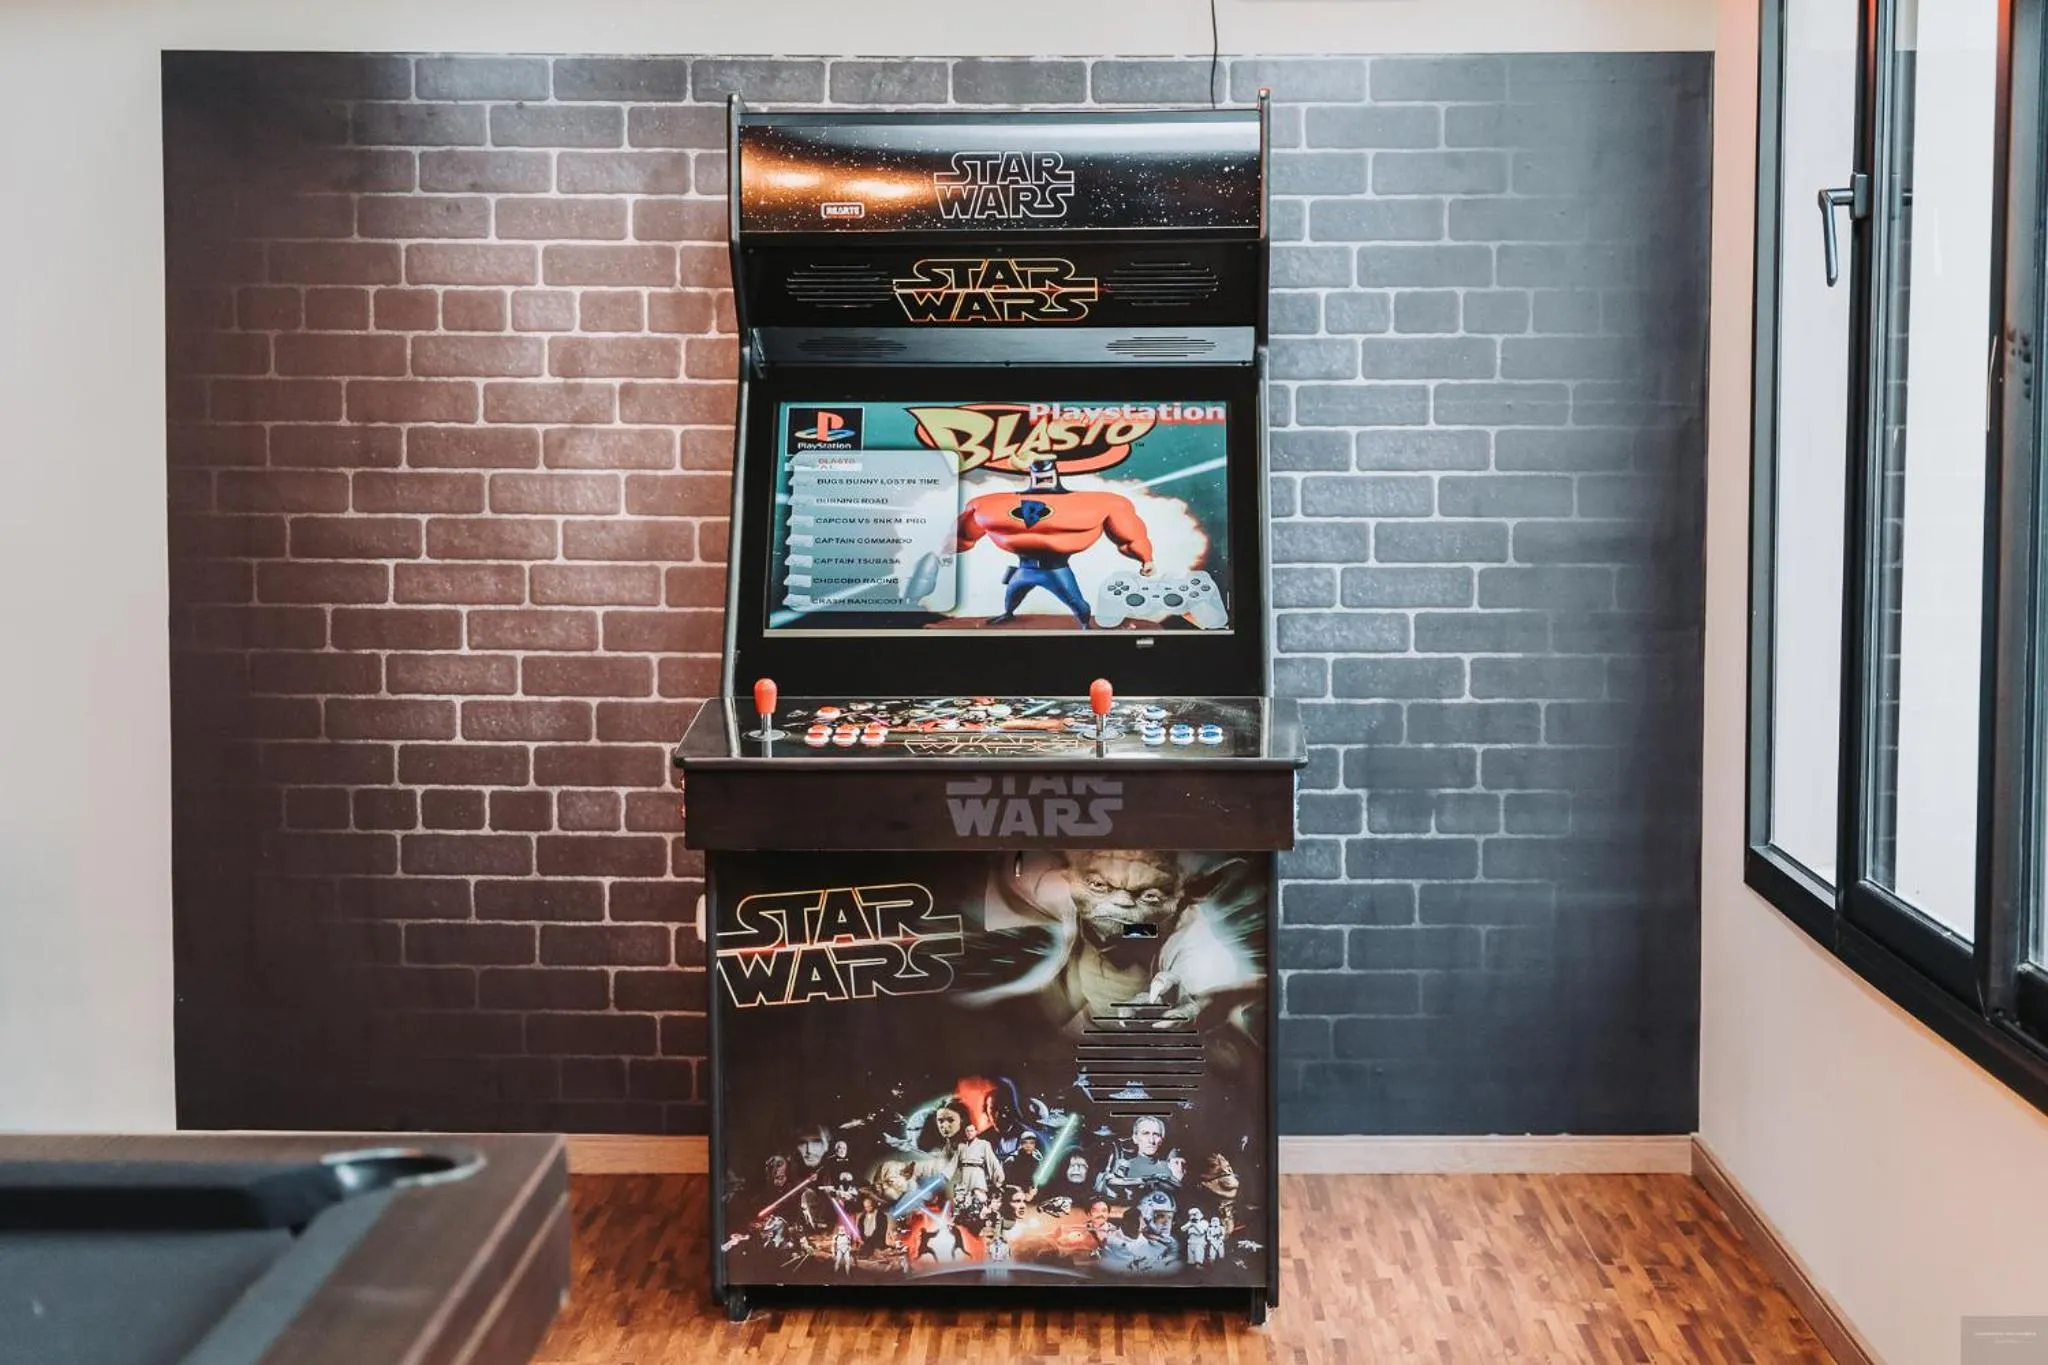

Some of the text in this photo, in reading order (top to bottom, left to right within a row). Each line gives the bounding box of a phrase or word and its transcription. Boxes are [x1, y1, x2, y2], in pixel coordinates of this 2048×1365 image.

[933, 151, 1076, 184] STAR
[934, 184, 1076, 218] WARS
[892, 258, 1098, 290] STAR
[893, 290, 1099, 323] WARS
[1028, 402, 1225, 424] Playstation
[797, 442, 852, 451] PlayStation
[905, 404, 1157, 473] BLASTO
[816, 478, 940, 486] BUGS BUNNY LOST IN TIME
[816, 497, 888, 505] BURNING ROAD
[815, 517, 857, 525] CAPCOM
[858, 517, 871, 525] VS
[873, 517, 893, 525] SNK
[905, 517, 927, 525] PRO
[814, 537, 913, 545] CAPTAIN COMMANDO
[813, 558, 901, 566] CAPTAIN TSUBASA
[812, 577, 899, 585] CHOCOBO RACING
[811, 597, 903, 606] CRASH BANDICOOT
[946, 797, 1124, 838] WARS
[716, 882, 963, 951] STAR
[716, 930, 964, 1008] WARS
